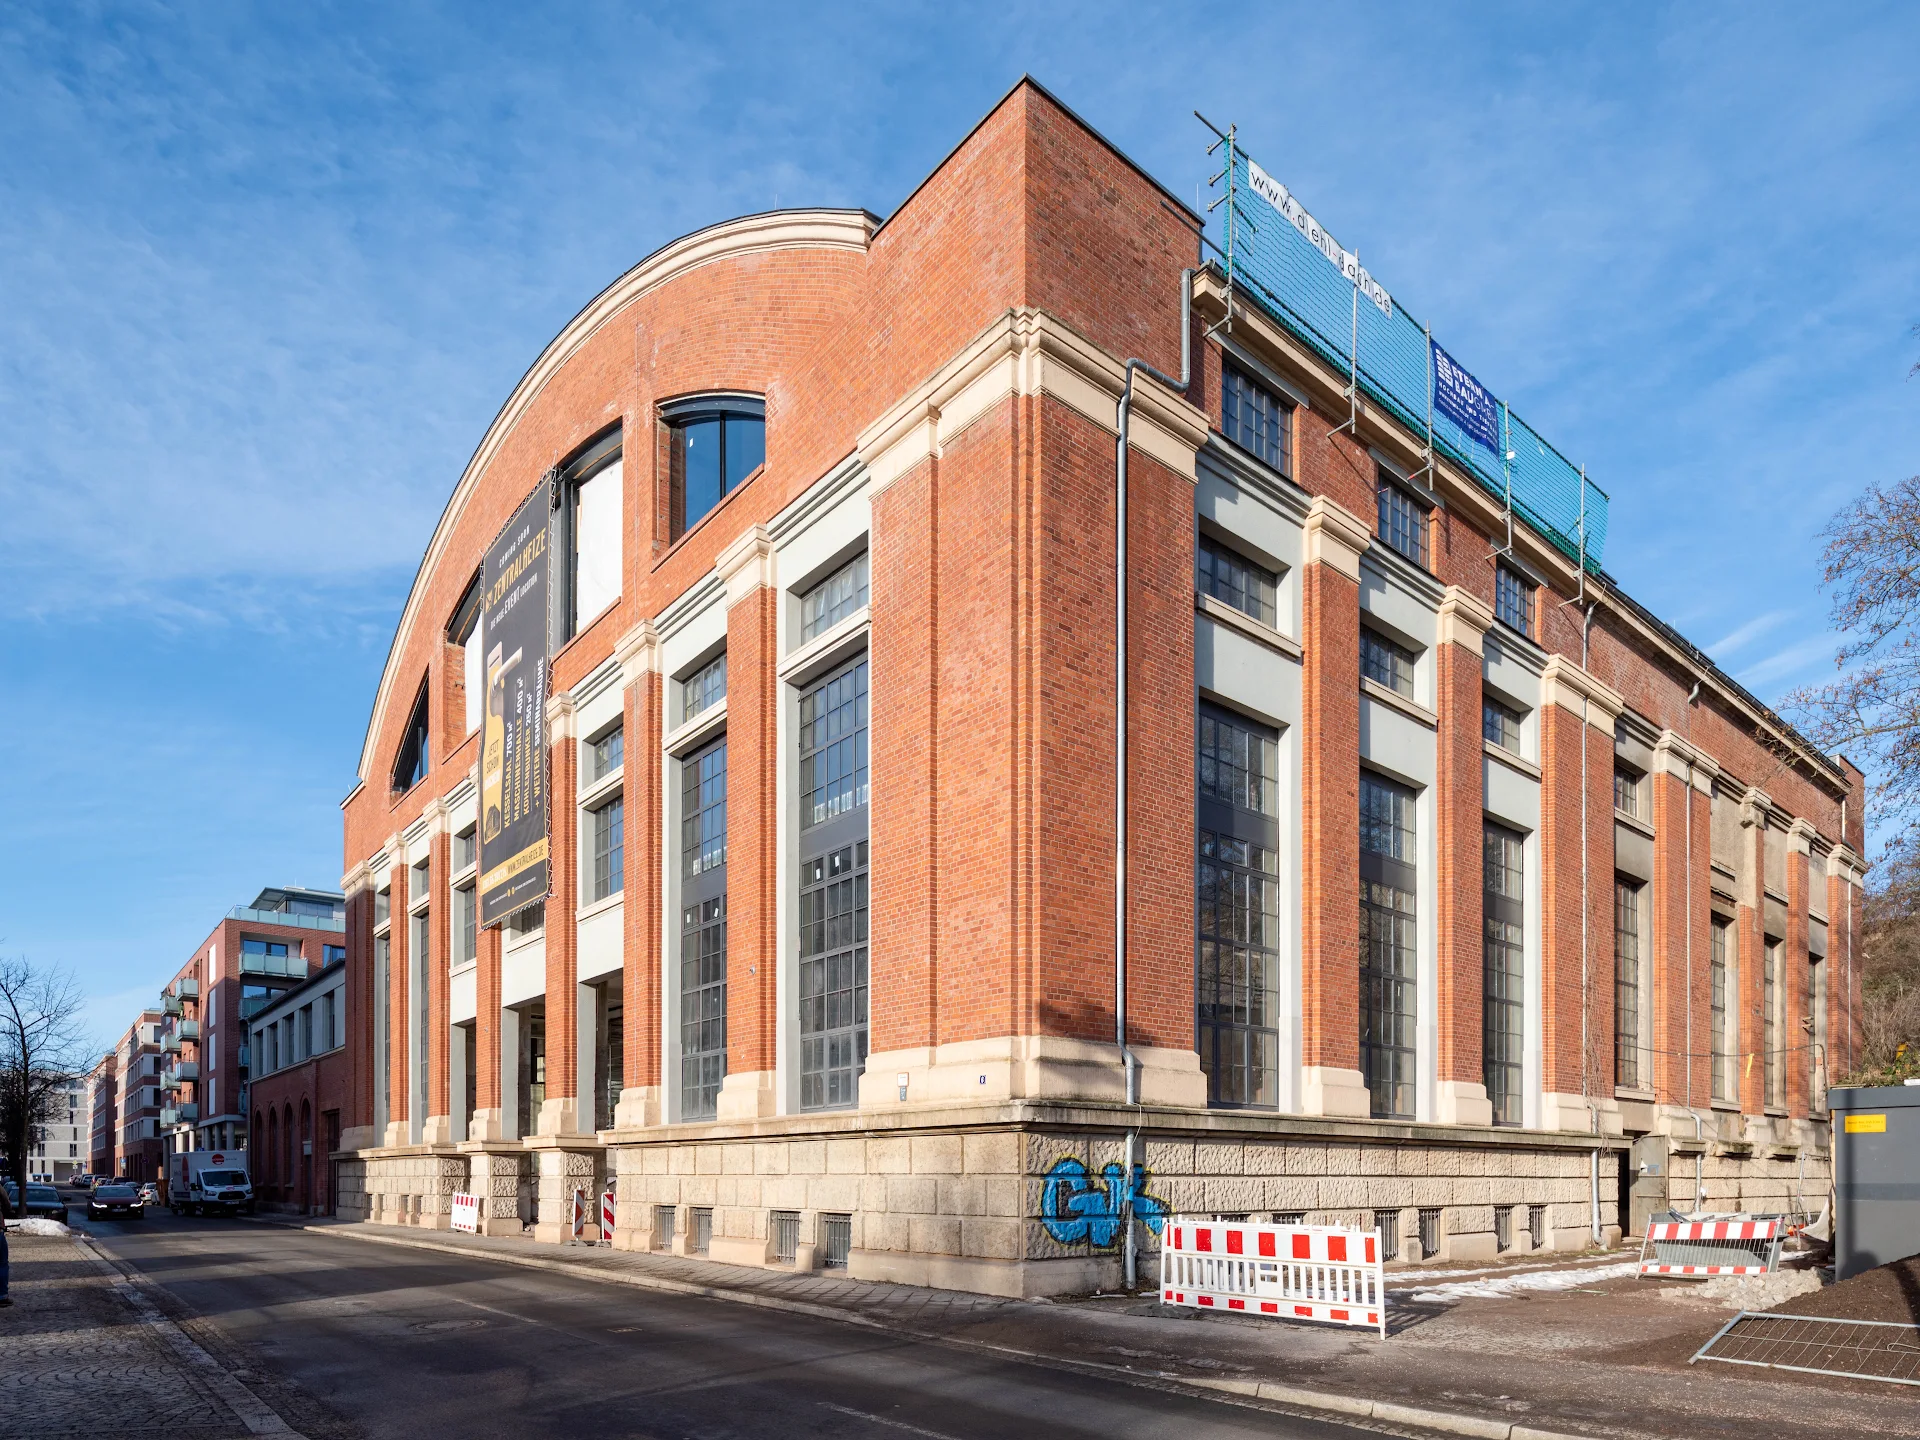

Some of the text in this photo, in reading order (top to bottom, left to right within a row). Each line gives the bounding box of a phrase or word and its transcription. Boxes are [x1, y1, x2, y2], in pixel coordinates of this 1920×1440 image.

[493, 527, 546, 606] ZENTRALHEIZE
[504, 585, 520, 615] EVENT
[516, 690, 524, 714] 400
[525, 703, 533, 726] 250
[534, 656, 544, 747] SEMINARRÄUME
[504, 757, 513, 828] KESSELSAAL
[513, 715, 523, 822] MASCHINENHALLE
[523, 727, 531, 815] KOHLENBUNKER
[533, 746, 541, 798] WEITERE
